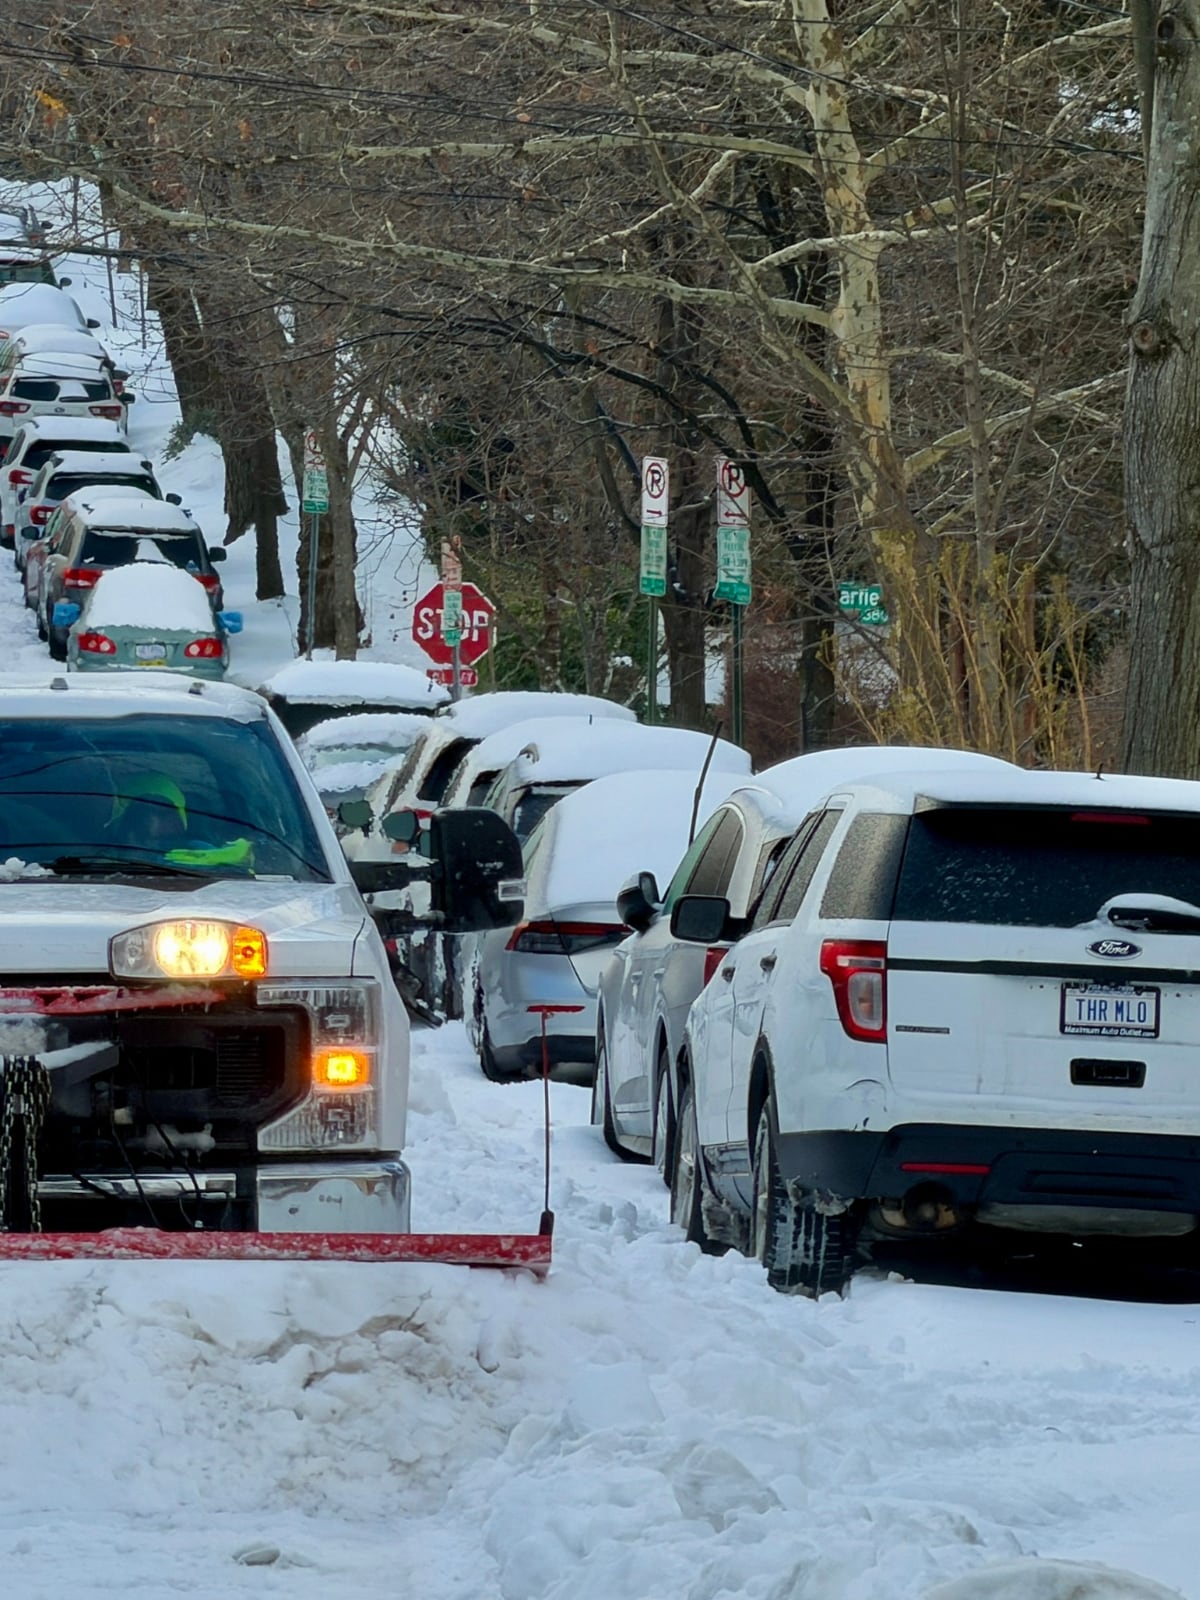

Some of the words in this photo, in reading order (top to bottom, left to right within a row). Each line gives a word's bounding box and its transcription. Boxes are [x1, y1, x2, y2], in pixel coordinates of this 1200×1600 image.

[1098, 940, 1131, 955] Ford
[1076, 998, 1108, 1022] THR
[1101, 1027, 1120, 1037] Auto
